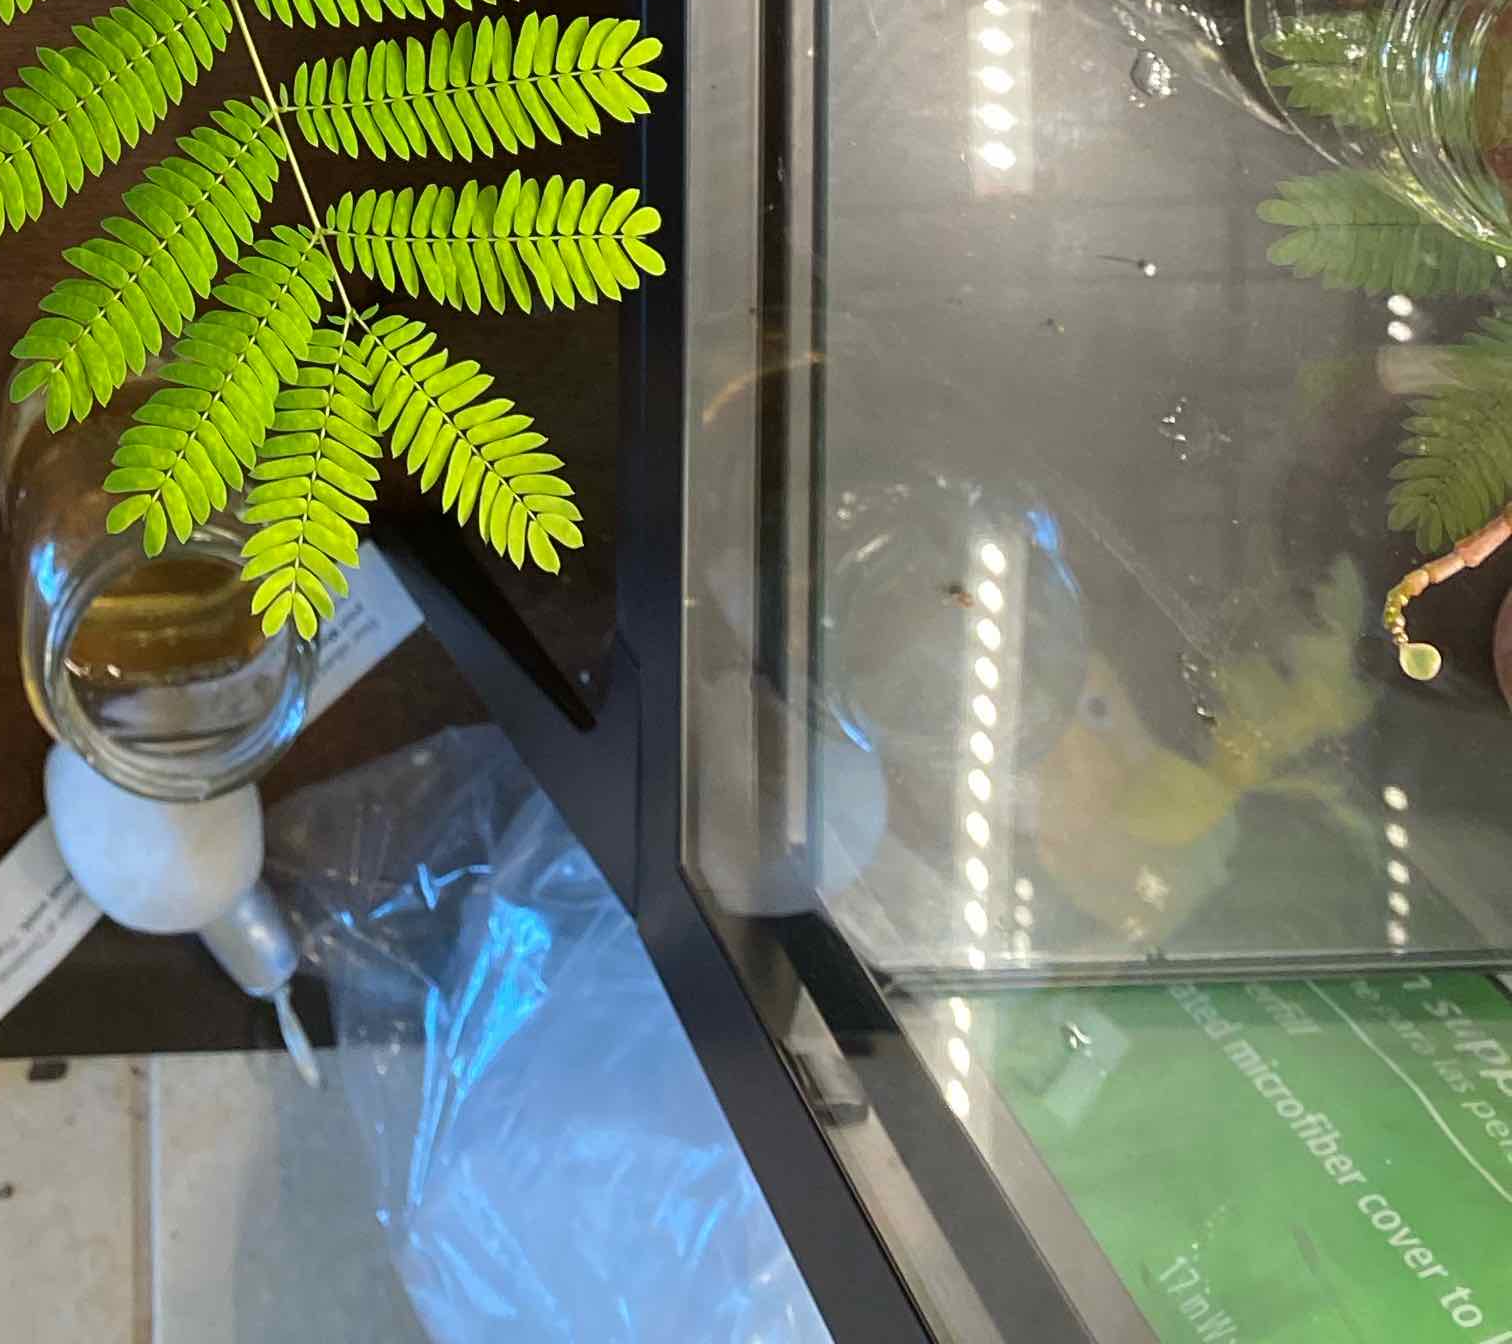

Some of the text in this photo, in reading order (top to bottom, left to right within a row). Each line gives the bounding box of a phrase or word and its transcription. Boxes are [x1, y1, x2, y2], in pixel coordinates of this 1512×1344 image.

[1222, 1038, 1367, 1185] microfiber
[1357, 1193, 1449, 1279] cover
[1440, 1285, 1484, 1328] to
